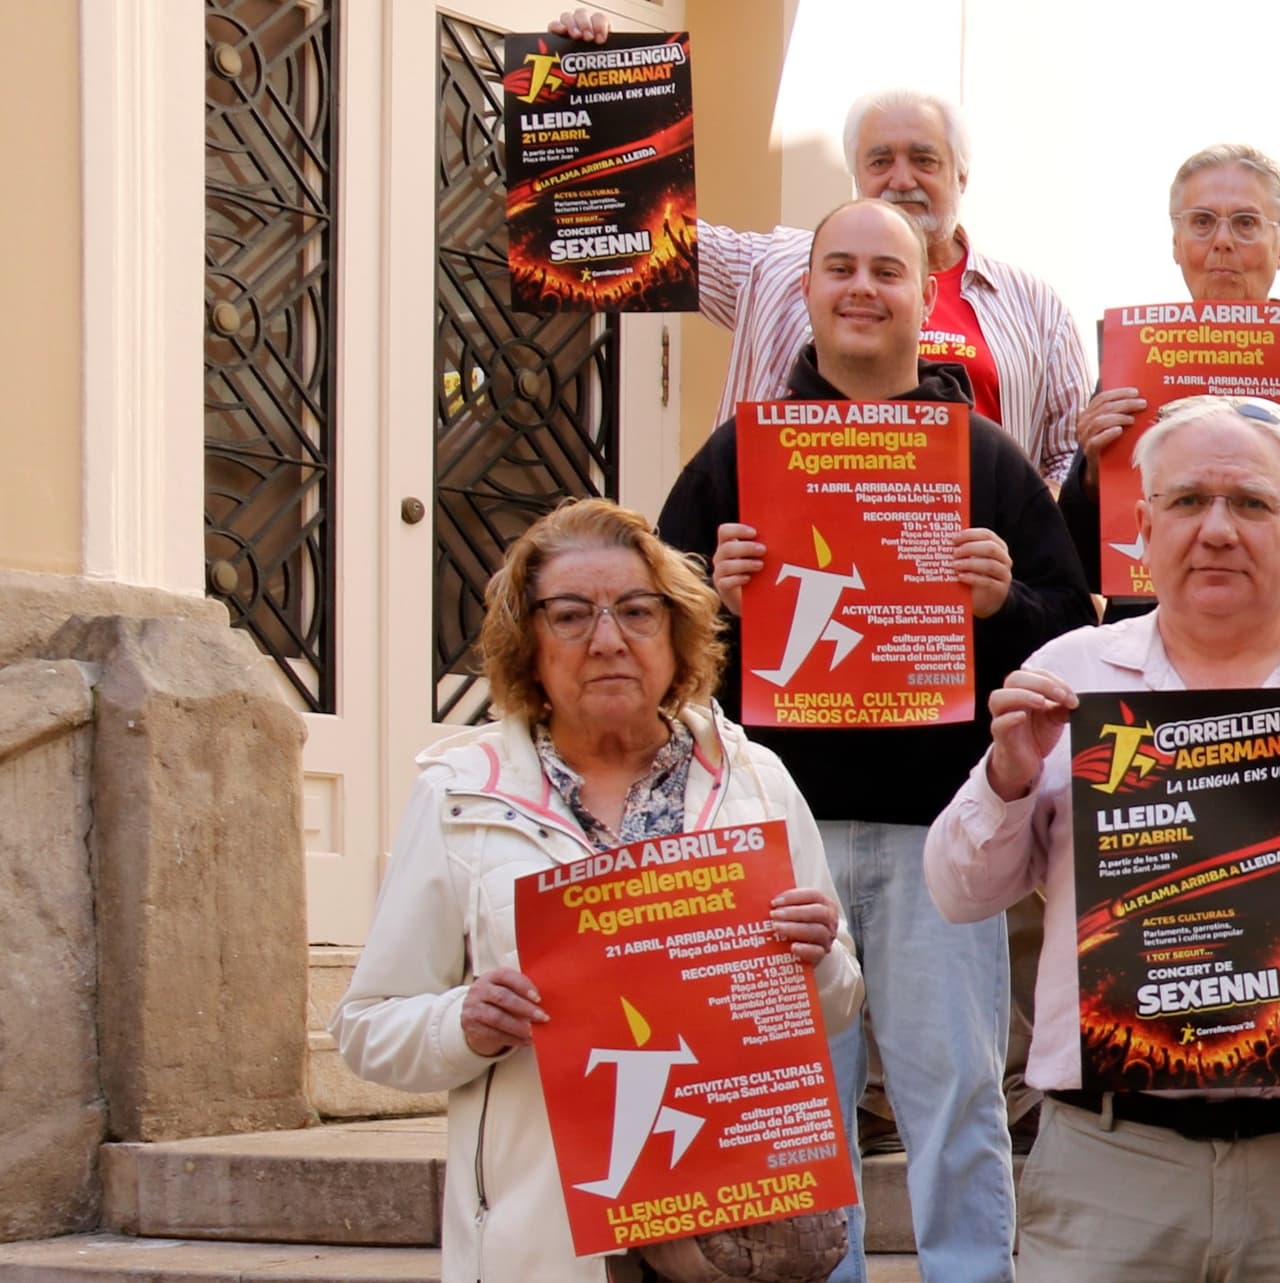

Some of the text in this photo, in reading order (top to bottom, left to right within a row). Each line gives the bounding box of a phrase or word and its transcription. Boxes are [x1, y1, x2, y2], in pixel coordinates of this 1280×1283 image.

[565, 46, 682, 71] CORRELLENGUA
[577, 64, 674, 87] AGERMANAT
[521, 111, 592, 131] LLEIDA
[522, 130, 590, 144] 21 D'ABRIL
[558, 225, 618, 237] CONCERT DE
[551, 231, 650, 260] SEXENNI
[1122, 306, 1198, 325] LLEIDA
[1140, 326, 1275, 347] Correllengua
[1146, 347, 1264, 367] Agermanat
[757, 405, 843, 425] LLEIDA
[780, 428, 927, 451] Correllengua
[788, 451, 916, 474] Agermanat
[807, 483, 961, 493] 21 ABRIL ARRIBADA A LLEIDA
[843, 606, 964, 615] ACTIVITATS CULTURALS
[774, 692, 944, 707] LLENGUA CULTURA
[845, 708, 939, 722] CATALANS
[1167, 780, 1183, 794] LA
[1187, 773, 1239, 791] LLENGUA
[1244, 767, 1267, 782] ENS
[1097, 801, 1196, 832] LLEIDA
[1099, 827, 1193, 850] 21 D'ABRIL
[538, 847, 636, 893] LLEIDA
[563, 862, 745, 908] Correllengua
[1123, 899, 1137, 912] LA
[1137, 885, 1180, 907] FLAMA
[1181, 868, 1228, 891] ARRIBA
[1229, 865, 1240, 875] A
[578, 888, 736, 935] Agermanat
[1148, 961, 1233, 980] CONCERT DE
[1137, 969, 1280, 1015] SEXENNI
[674, 1063, 822, 1098] ACTIVITATS CULTURALS
[607, 1171, 817, 1225] LLENGUA CULTURA
[698, 1191, 815, 1229] CATALANS
